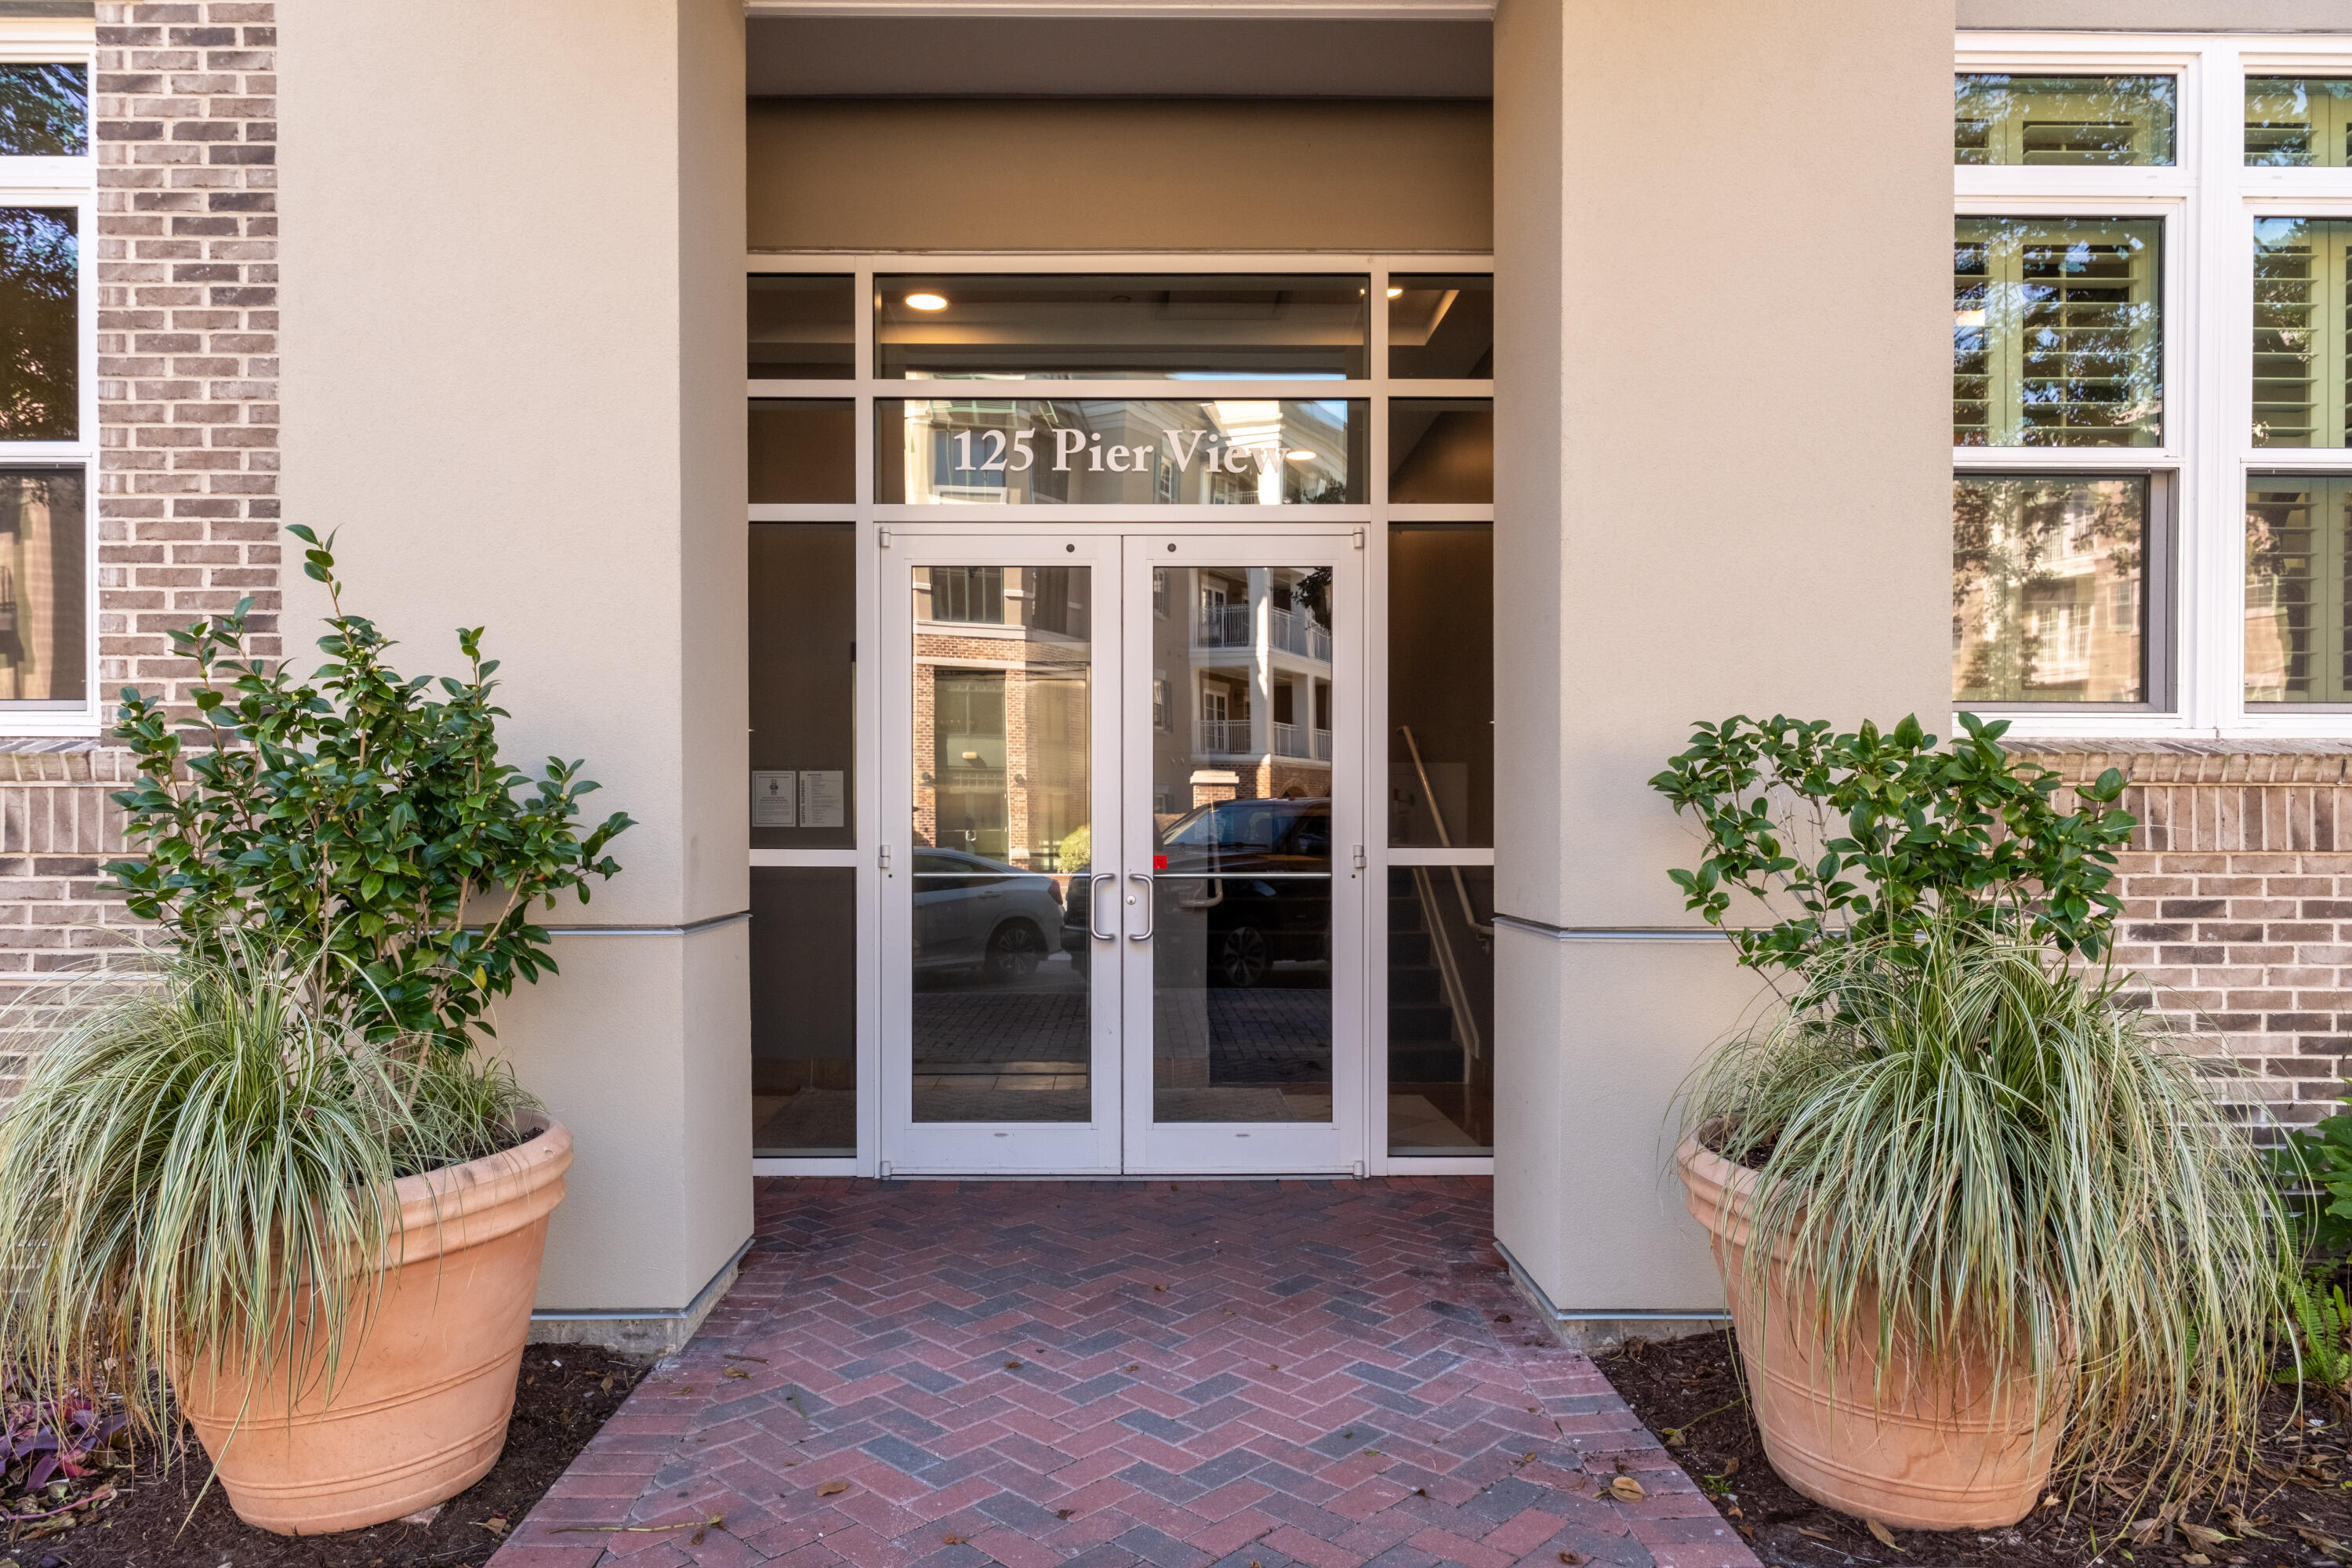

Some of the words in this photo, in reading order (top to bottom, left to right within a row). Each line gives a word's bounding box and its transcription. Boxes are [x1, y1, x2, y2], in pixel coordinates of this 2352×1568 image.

[953, 427, 1036, 472] 125
[1051, 428, 1154, 472] Pier
[1163, 429, 1290, 474] View
